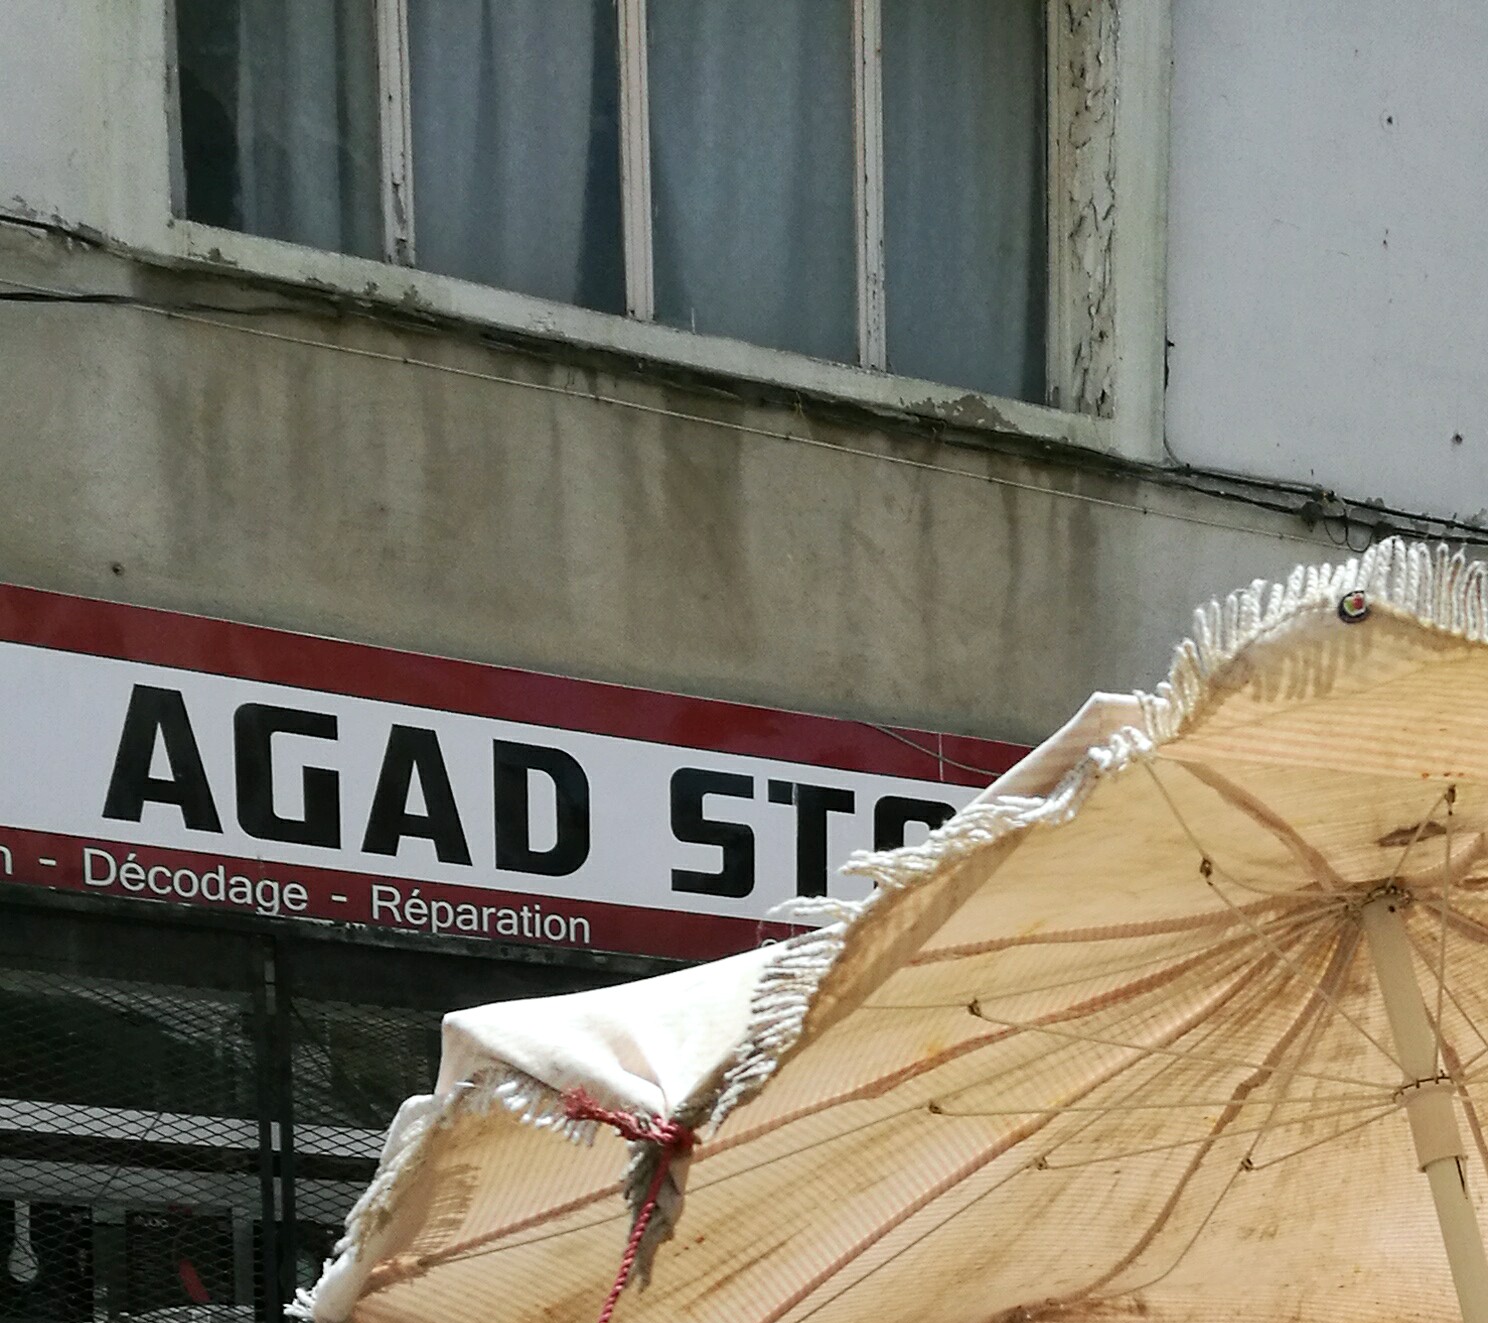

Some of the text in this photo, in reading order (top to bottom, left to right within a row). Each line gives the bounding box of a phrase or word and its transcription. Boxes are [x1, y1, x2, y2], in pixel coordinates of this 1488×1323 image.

[102, 683, 591, 877] AGAD
[83, 847, 308, 916] Décodage
[371, 884, 591, 944] Réparation
